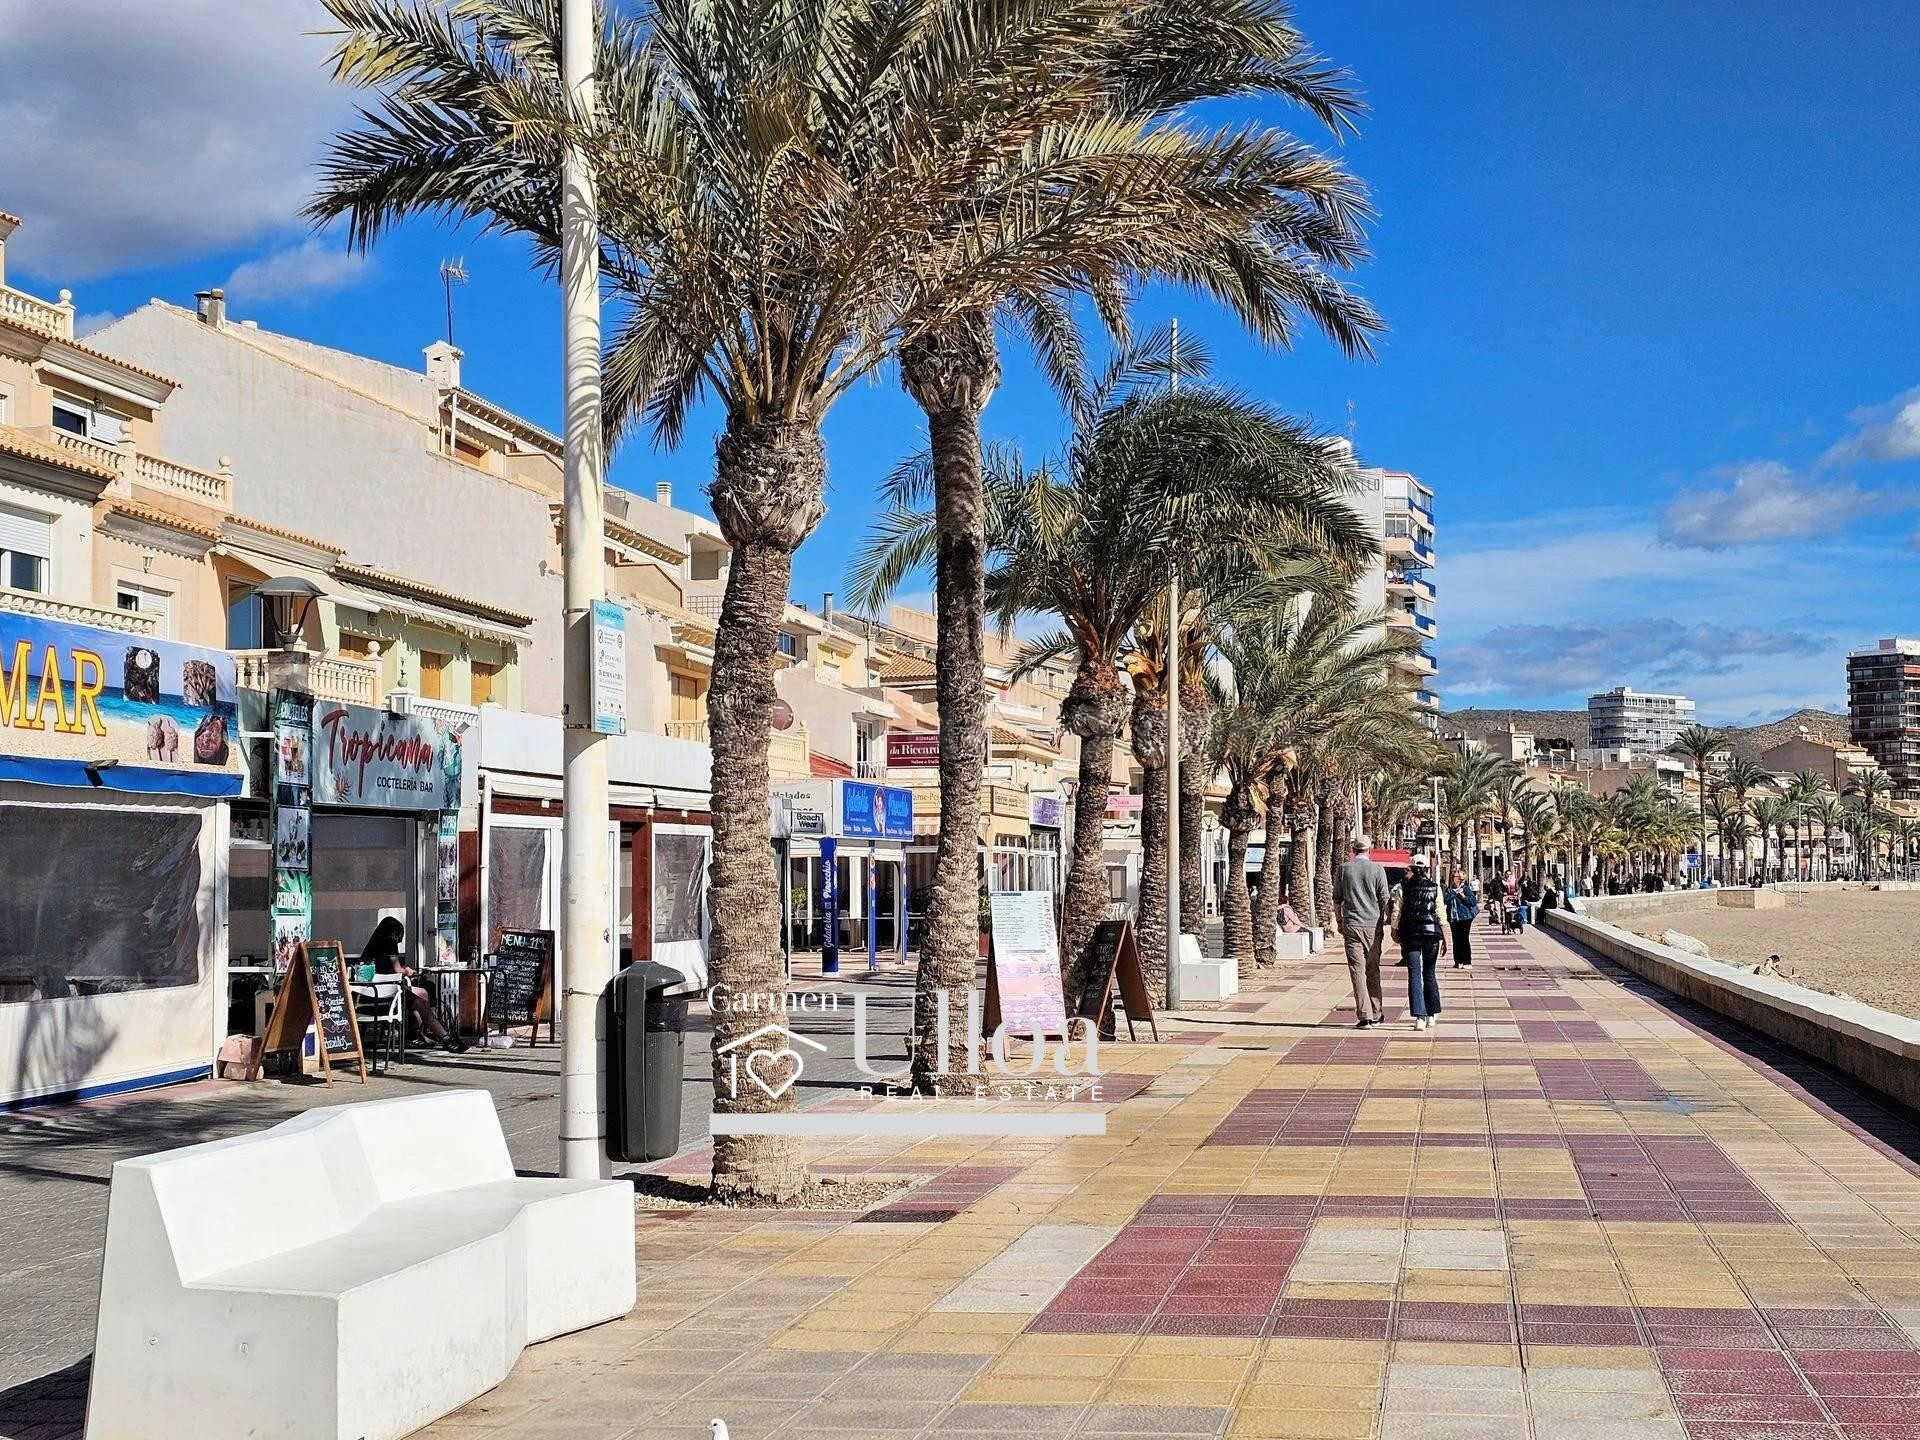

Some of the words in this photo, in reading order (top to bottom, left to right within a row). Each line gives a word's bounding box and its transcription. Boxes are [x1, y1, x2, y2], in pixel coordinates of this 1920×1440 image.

[321, 710, 433, 798] Tropicana
[376, 775, 417, 791] COCTELERÍA
[420, 781, 434, 793] BAR
[796, 813, 821, 822] Beach
[798, 820, 819, 828] Wear
[822, 860, 832, 899] Pinocchio
